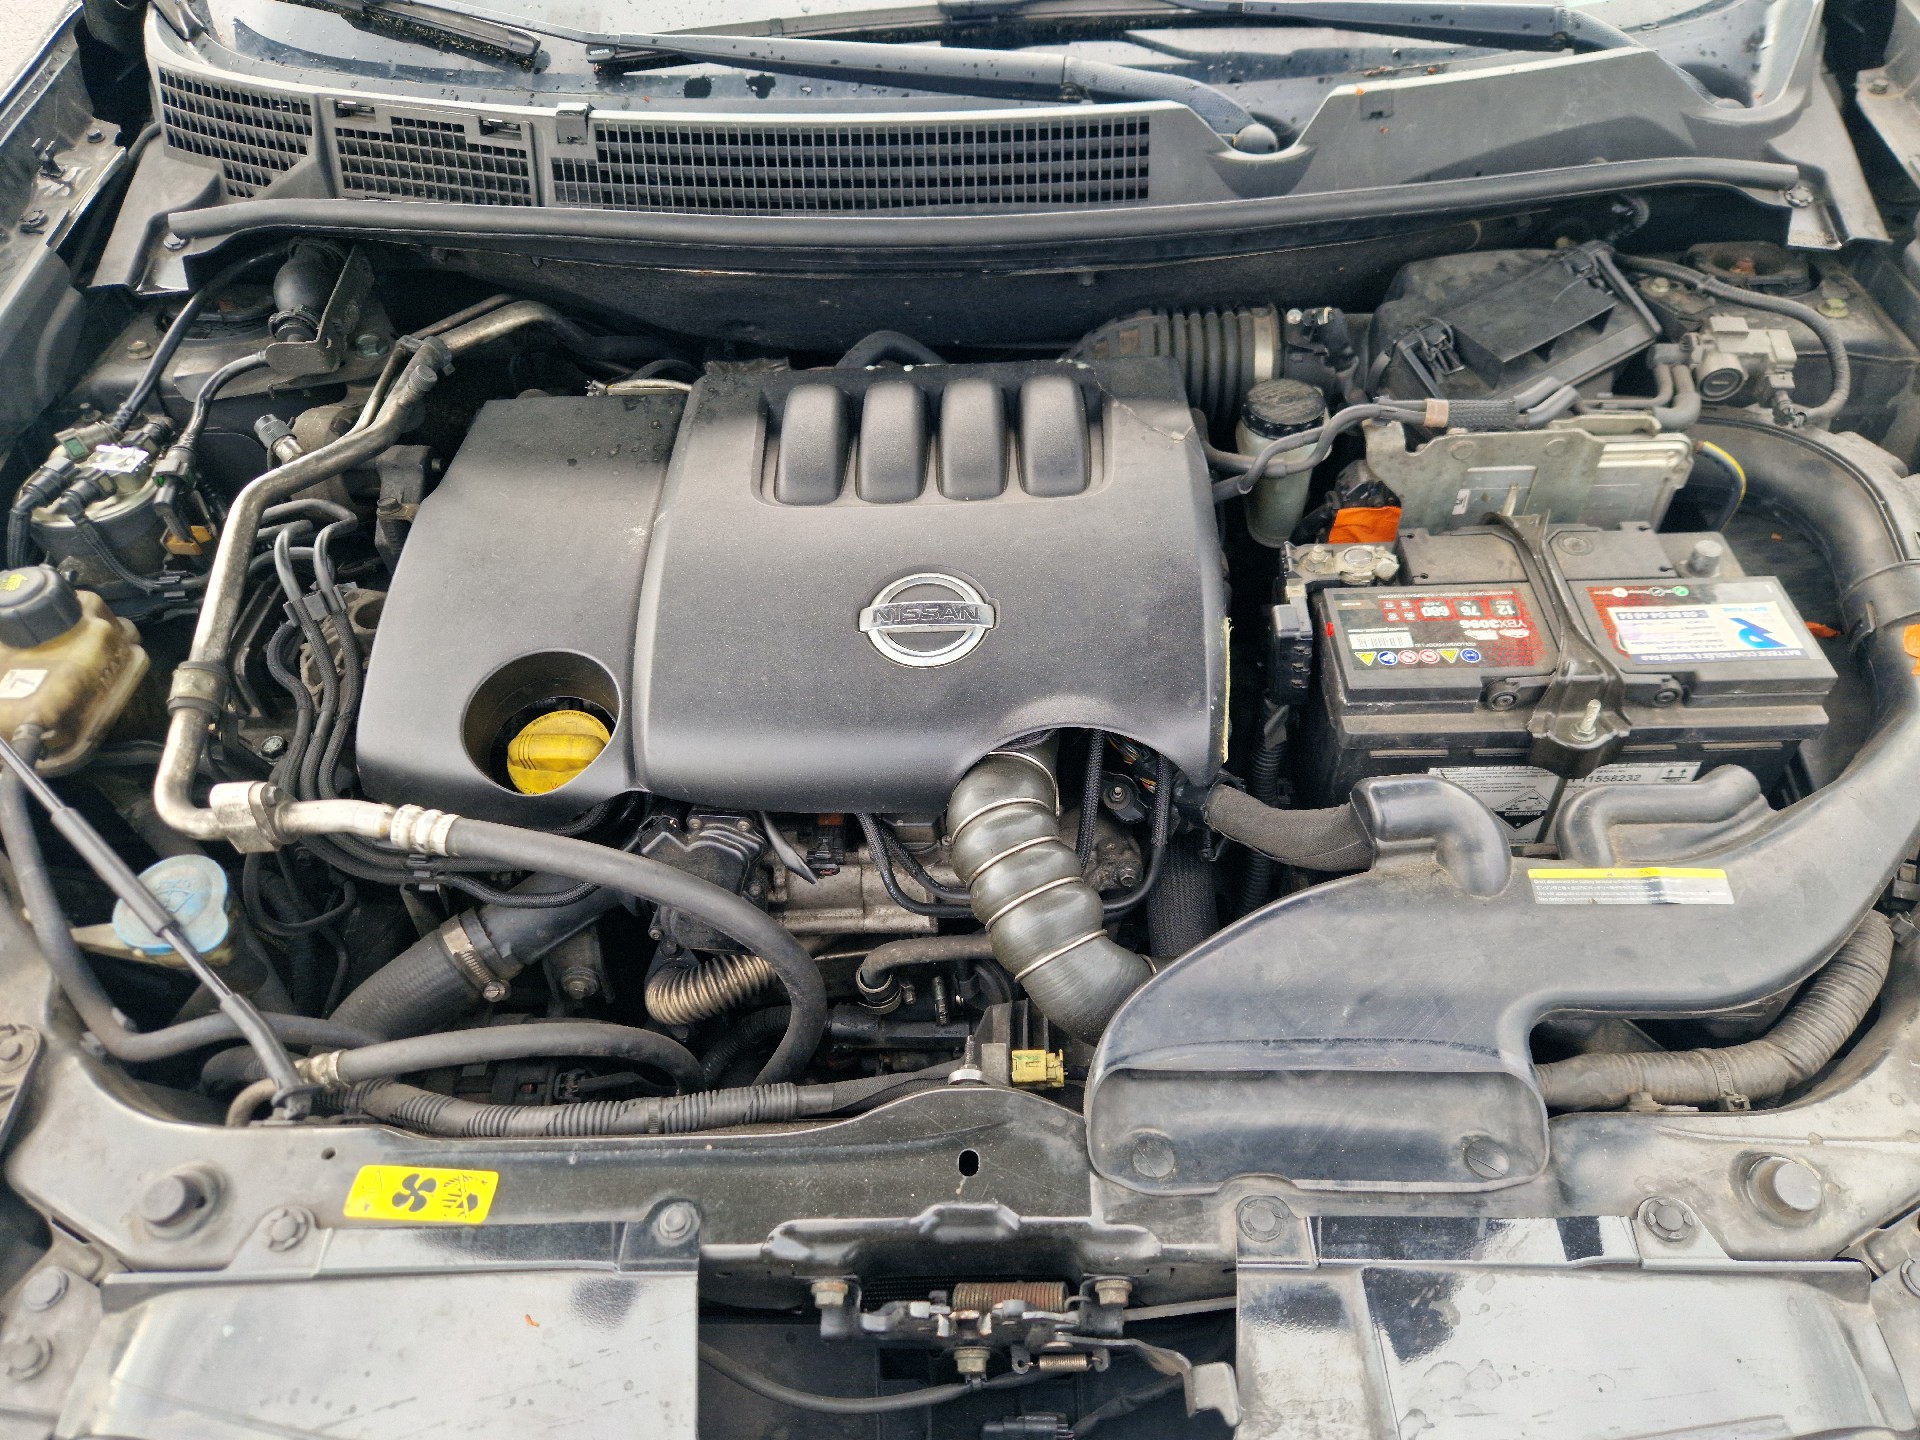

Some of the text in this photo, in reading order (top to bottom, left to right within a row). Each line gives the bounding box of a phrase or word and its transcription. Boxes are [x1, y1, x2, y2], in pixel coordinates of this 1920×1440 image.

[872, 605, 980, 624] NISSAN
[1421, 605, 1450, 618] 680
[1460, 605, 1481, 616] 76
[1496, 605, 1516, 616] 12
[1459, 619, 1526, 629] YBX3096
